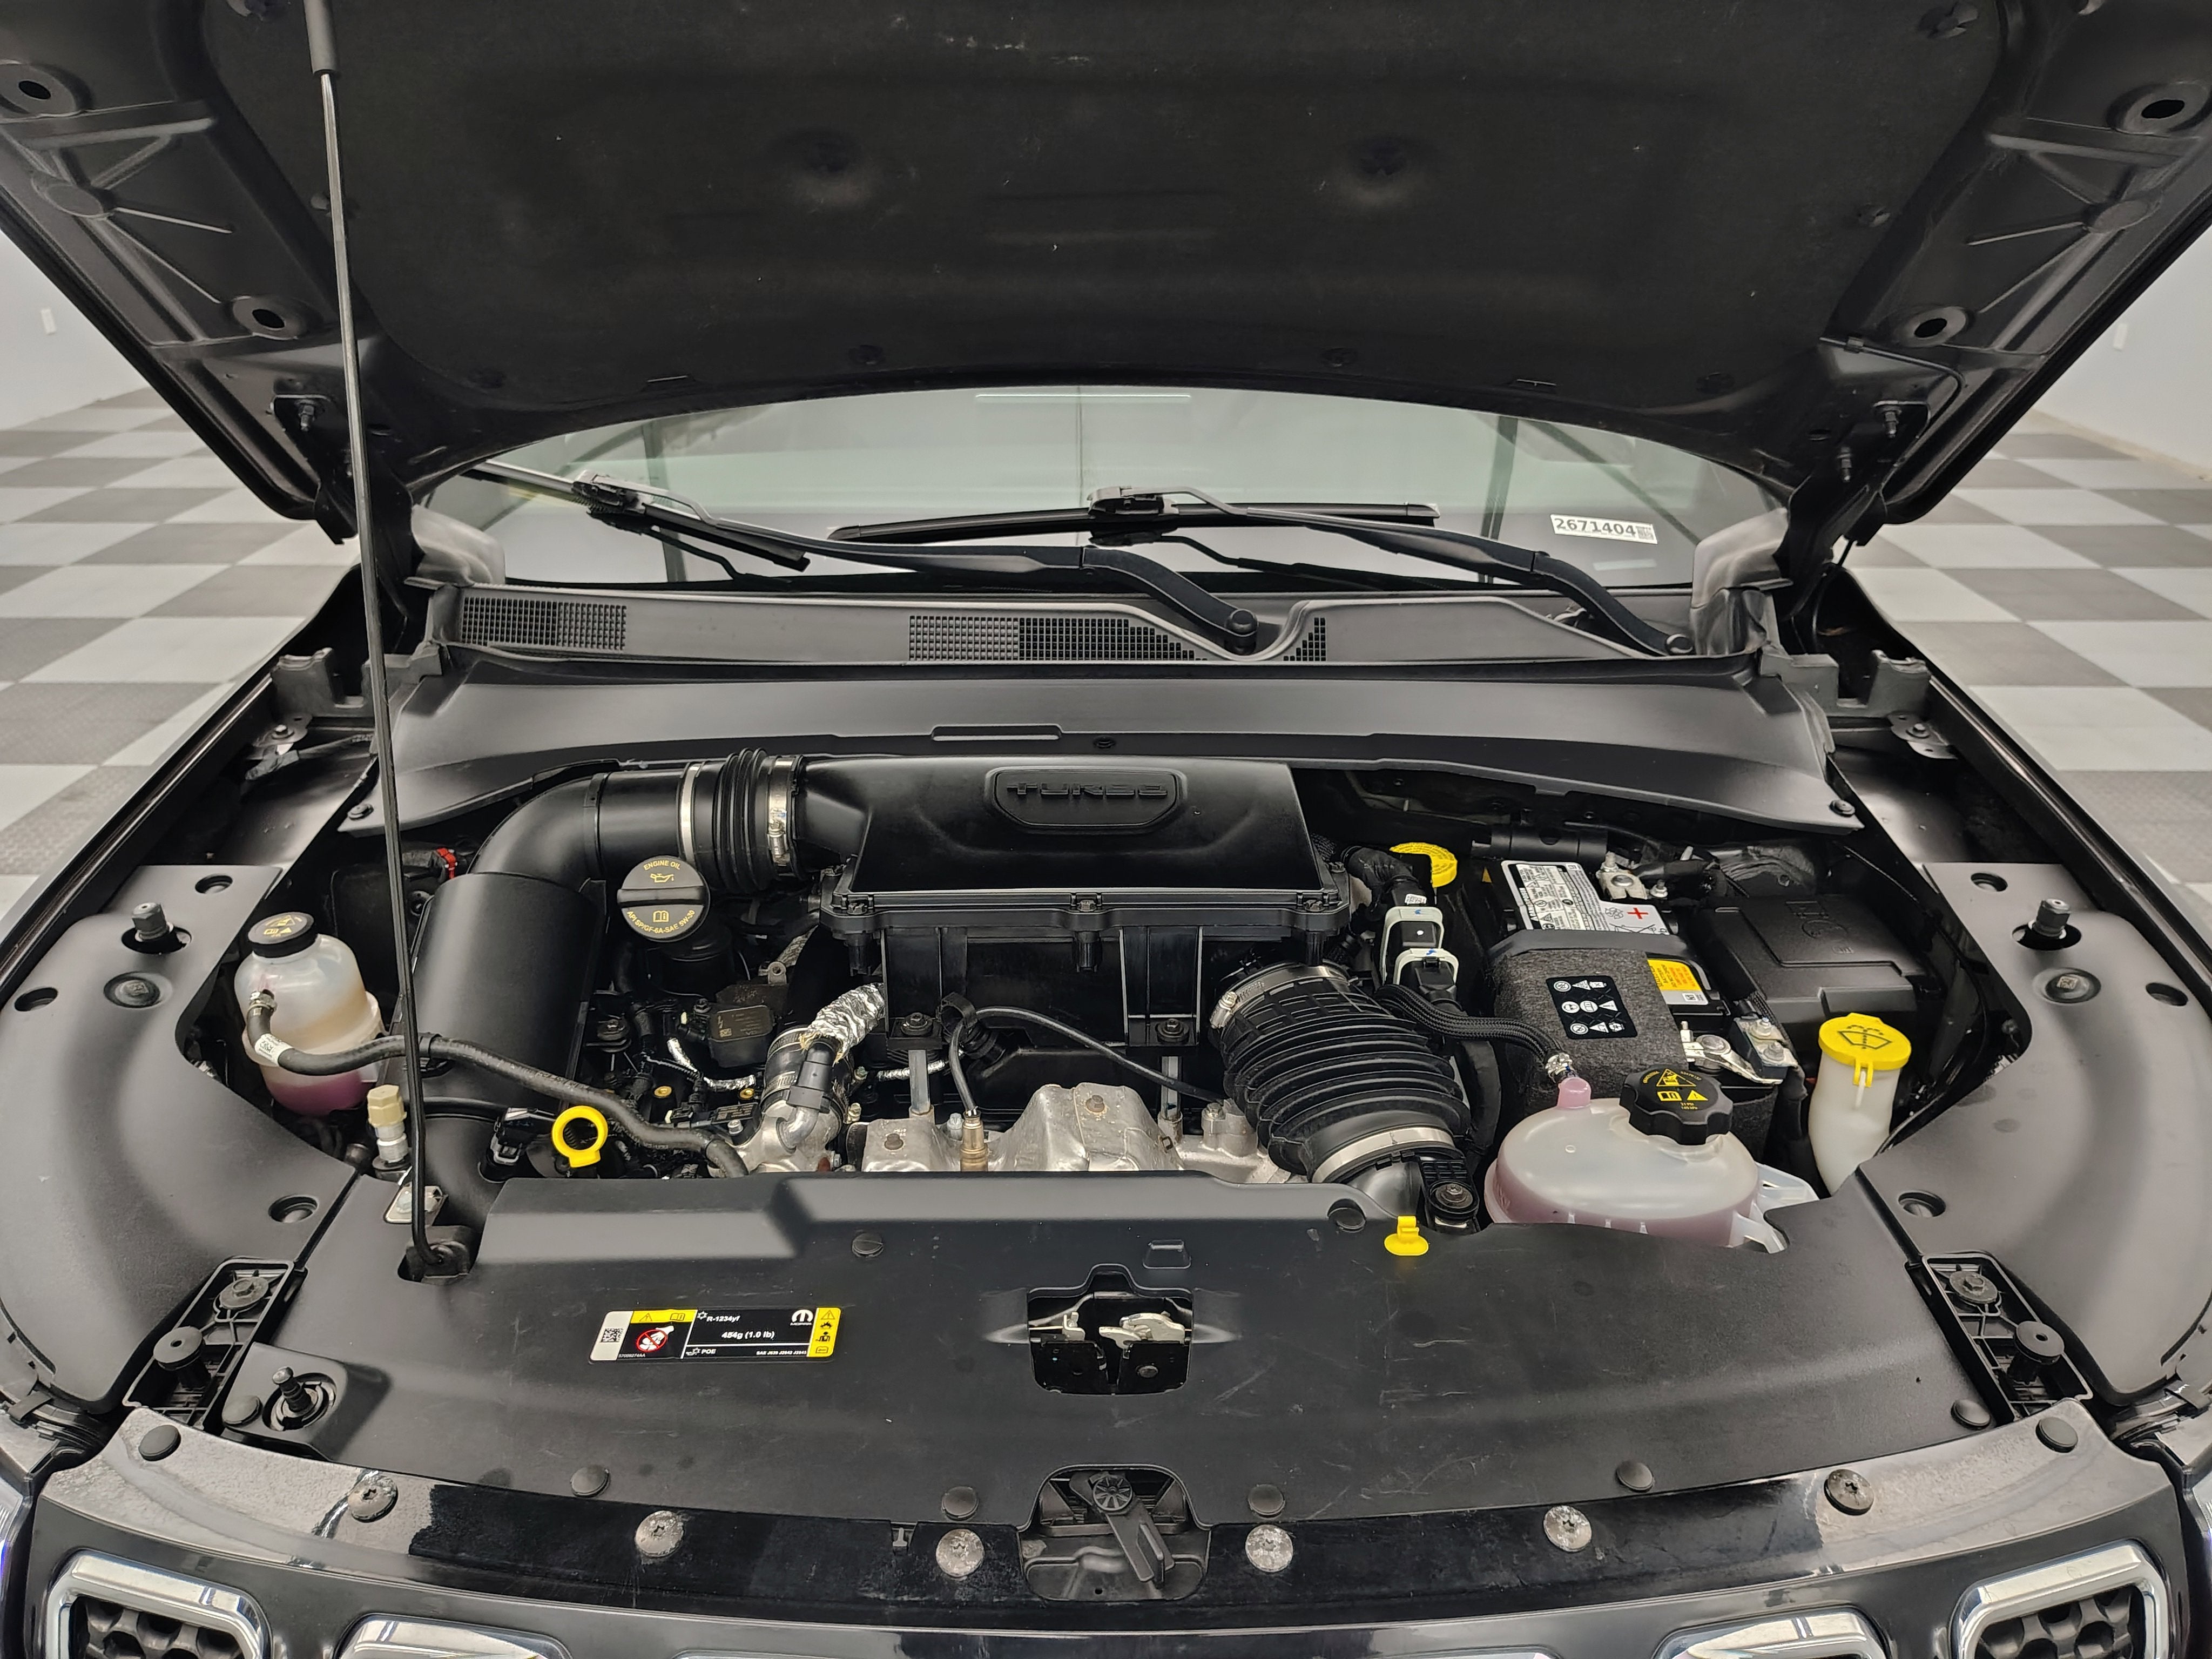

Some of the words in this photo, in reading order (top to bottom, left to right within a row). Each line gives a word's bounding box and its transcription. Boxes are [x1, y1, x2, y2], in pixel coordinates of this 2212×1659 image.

[1554, 518, 1636, 535] 2671404
[643, 860, 669, 870] ENGINE
[670, 861, 681, 869] OIL
[627, 911, 636, 922] API
[679, 910, 696, 927] 5W-30
[721, 1331, 743, 1339] 454g
[745, 1331, 761, 1339] (1.0
[763, 1331, 775, 1339] lb)
